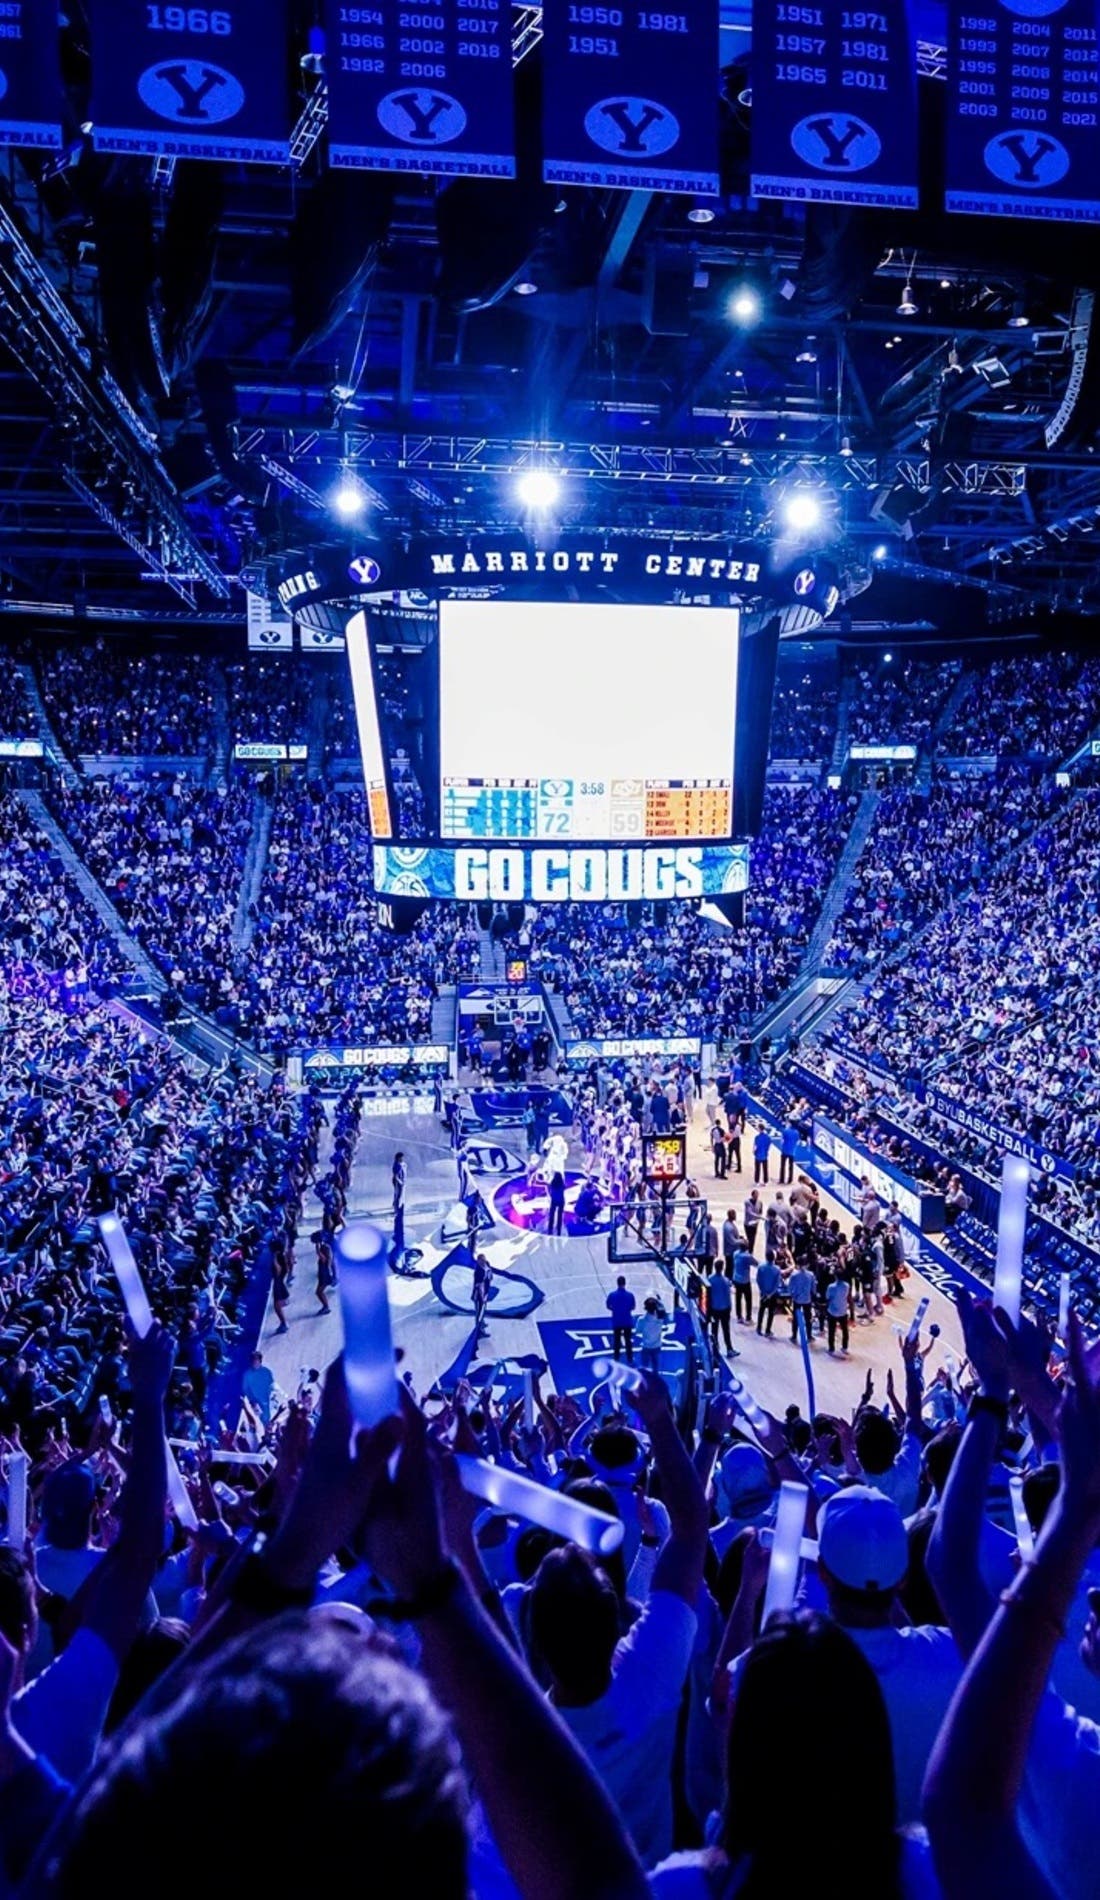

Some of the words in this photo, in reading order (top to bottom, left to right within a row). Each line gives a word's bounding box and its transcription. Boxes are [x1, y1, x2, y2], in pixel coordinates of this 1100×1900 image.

[147, 5, 232, 36] 1966
[340, 8, 384, 25] 1954
[400, 13, 445, 30] 2000
[457, 18, 499, 34] 2017
[568, 5, 623, 27] 1950
[637, 12, 688, 33] 1981
[776, 5, 824, 26] 1951
[842, 11, 889, 33] 1971
[960, 16, 997, 32] 1992
[1012, 22, 1050, 37] 2004
[1064, 27, 1097, 41] 2011
[340, 32, 385, 49] 1966
[400, 38, 445, 54] 2002
[458, 42, 500, 58] 2018
[568, 36, 620, 57] 1951
[776, 33, 826, 55] 1957
[842, 40, 889, 62] 1981
[960, 38, 997, 53] 1993
[1012, 43, 1050, 58] 2007
[1064, 48, 1099, 62] 2012
[341, 56, 385, 74] 1982
[401, 62, 446, 78] 2006
[776, 64, 827, 85] 1965
[842, 70, 889, 91] 2011
[960, 60, 996, 74] 1995
[1012, 64, 1050, 79] 2008
[1064, 70, 1099, 83] 2014
[155, 64, 228, 118] Y
[960, 81, 996, 96] 2001
[1011, 86, 1050, 100] 2009
[1063, 91, 1098, 104] 2015
[390, 91, 452, 140] Y
[600, 101, 665, 152] Y
[960, 102, 998, 117] 2003
[1011, 107, 1047, 121] 2010
[1063, 112, 1097, 126] 2021
[99, 137, 158, 153] MEN'S
[163, 142, 291, 162] BASKETBALL
[806, 118, 867, 167] Y
[333, 153, 392, 169] MEN'S
[396, 156, 512, 177] BASKETBALL
[998, 134, 1056, 184] Y
[546, 169, 600, 184] MEN'S
[606, 172, 717, 194] BASKETBALL
[754, 183, 806, 199] MEN'S
[810, 186, 917, 208] BASKETBALL
[949, 199, 997, 214] MEN'S
[350, 557, 378, 584] Y
[431, 552, 618, 574] MARRIOTT
[646, 554, 760, 583] CENTER
[795, 569, 815, 594] Y
[238, 746, 250, 756] GO
[580, 783, 605, 795] 3:58
[543, 813, 570, 833] 72
[613, 813, 639, 833] 59
[455, 848, 524, 900] GO
[531, 848, 703, 901] COUGS
[343, 1049, 362, 1065] GO
[364, 1047, 410, 1064] COUGS
